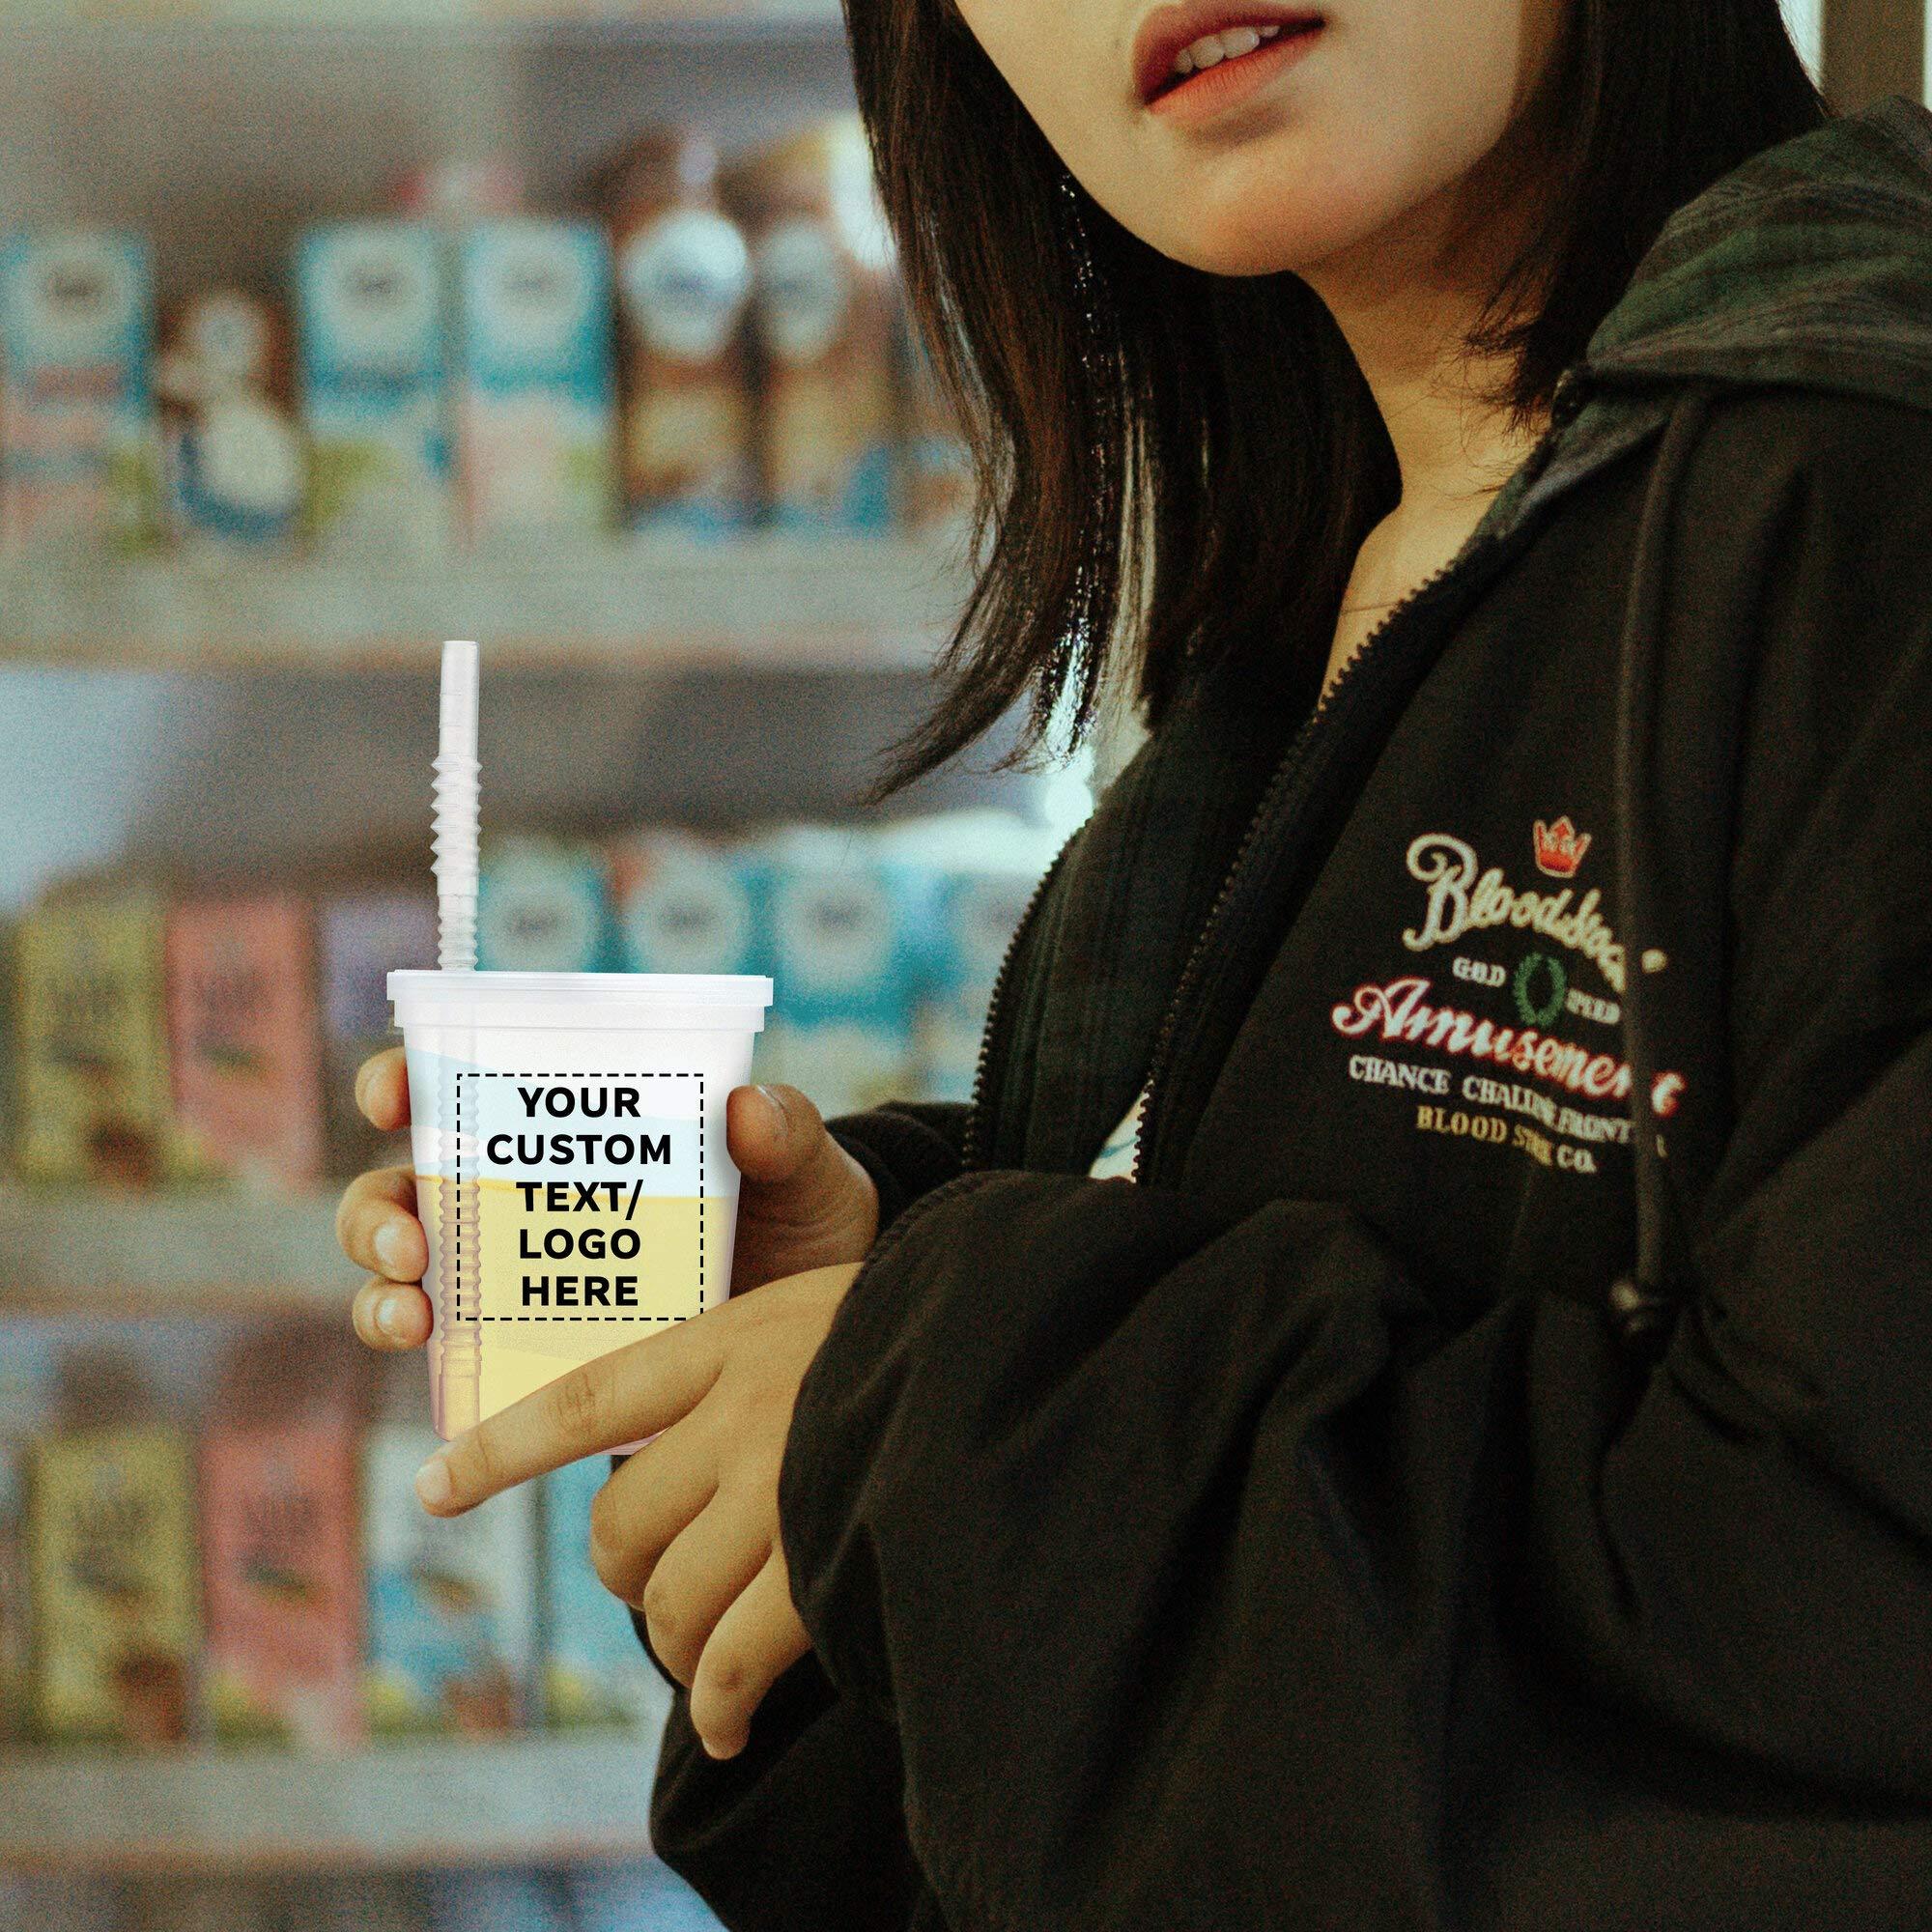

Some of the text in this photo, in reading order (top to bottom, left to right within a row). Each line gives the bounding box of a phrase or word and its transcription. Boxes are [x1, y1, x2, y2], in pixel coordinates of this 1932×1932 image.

[1350, 1054, 1451, 1095] CHANCE
[518, 1088, 640, 1118] YOUR
[1416, 1105, 1507, 1144] BLOOD
[488, 1134, 669, 1164] CUSTOM
[516, 1179, 643, 1220] TEXT/
[521, 1229, 639, 1259] LOGO
[523, 1276, 638, 1305] HERE
